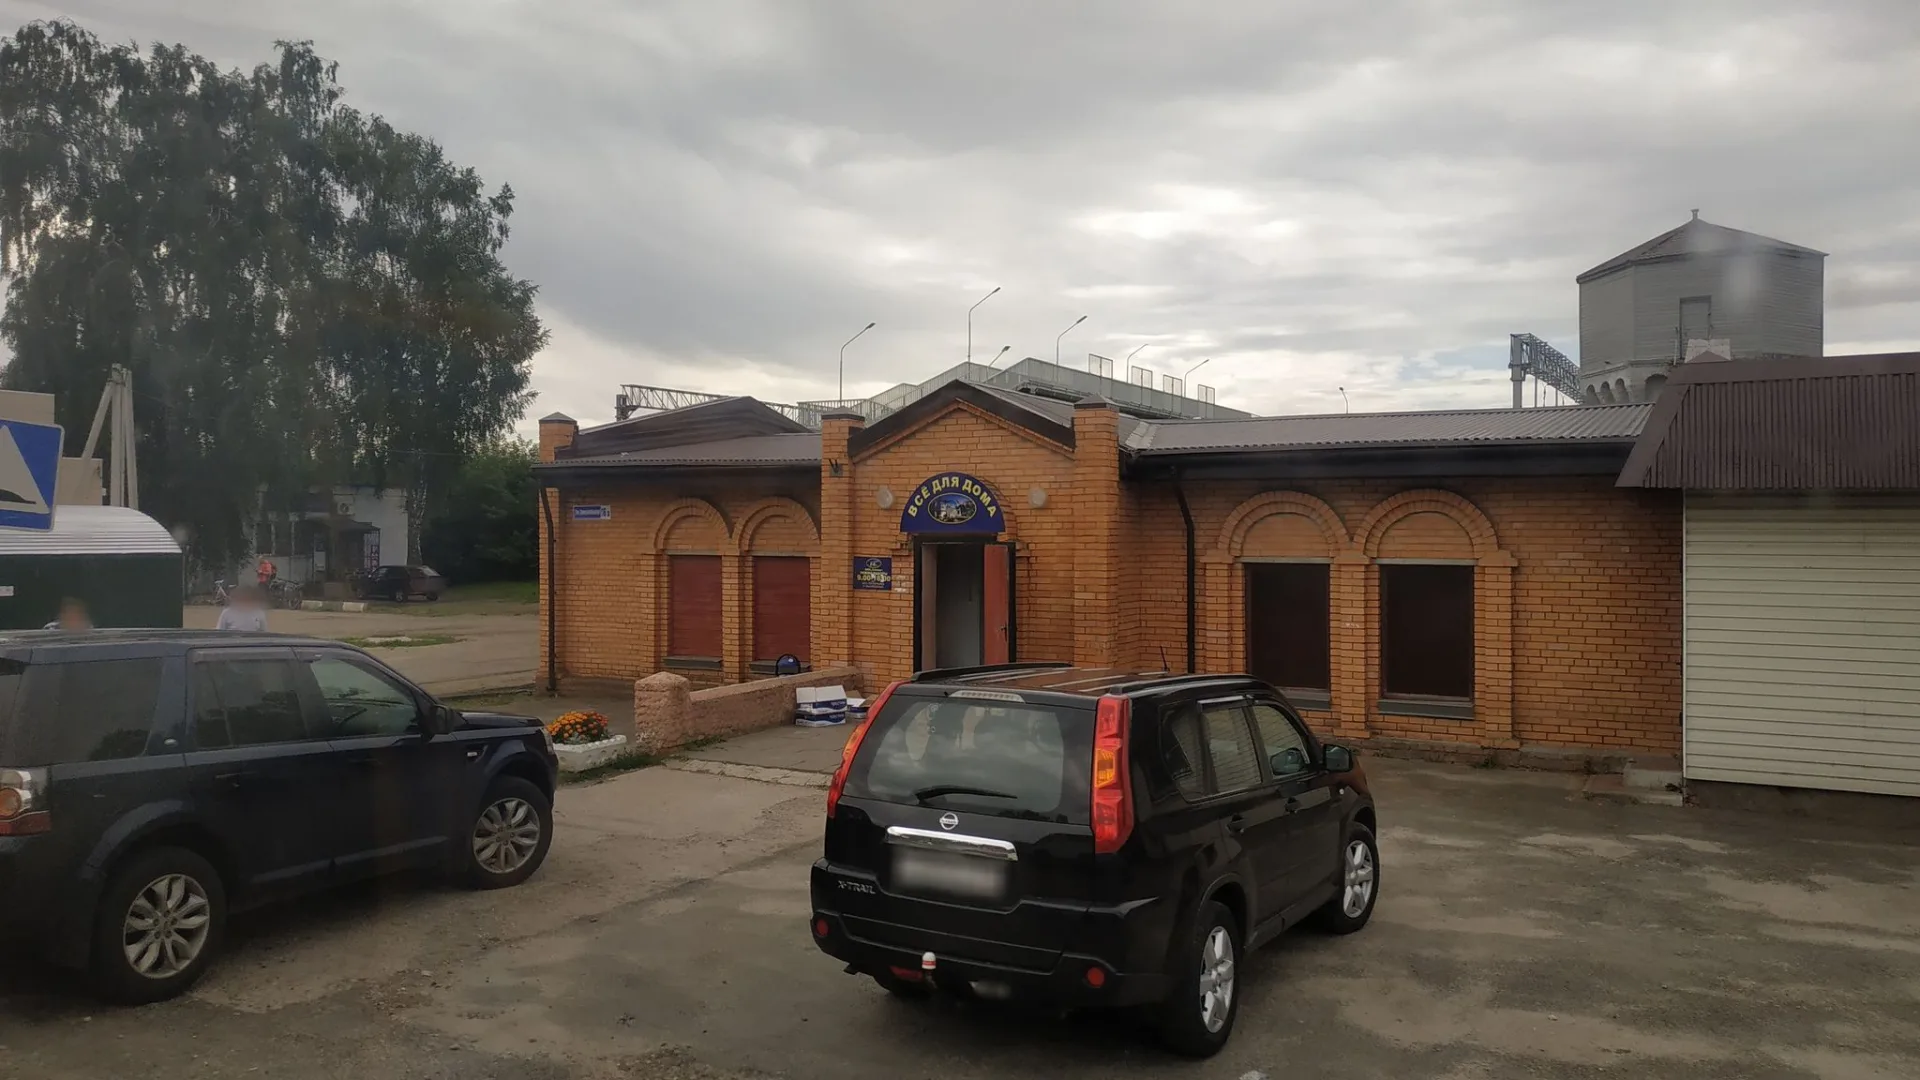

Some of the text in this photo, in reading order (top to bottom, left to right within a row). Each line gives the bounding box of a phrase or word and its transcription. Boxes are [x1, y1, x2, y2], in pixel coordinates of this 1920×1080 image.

[932, 476, 959, 494] ДЛЯ
[962, 479, 996, 517] ДОМА
[838, 880, 876, 894] X-TRAIL
